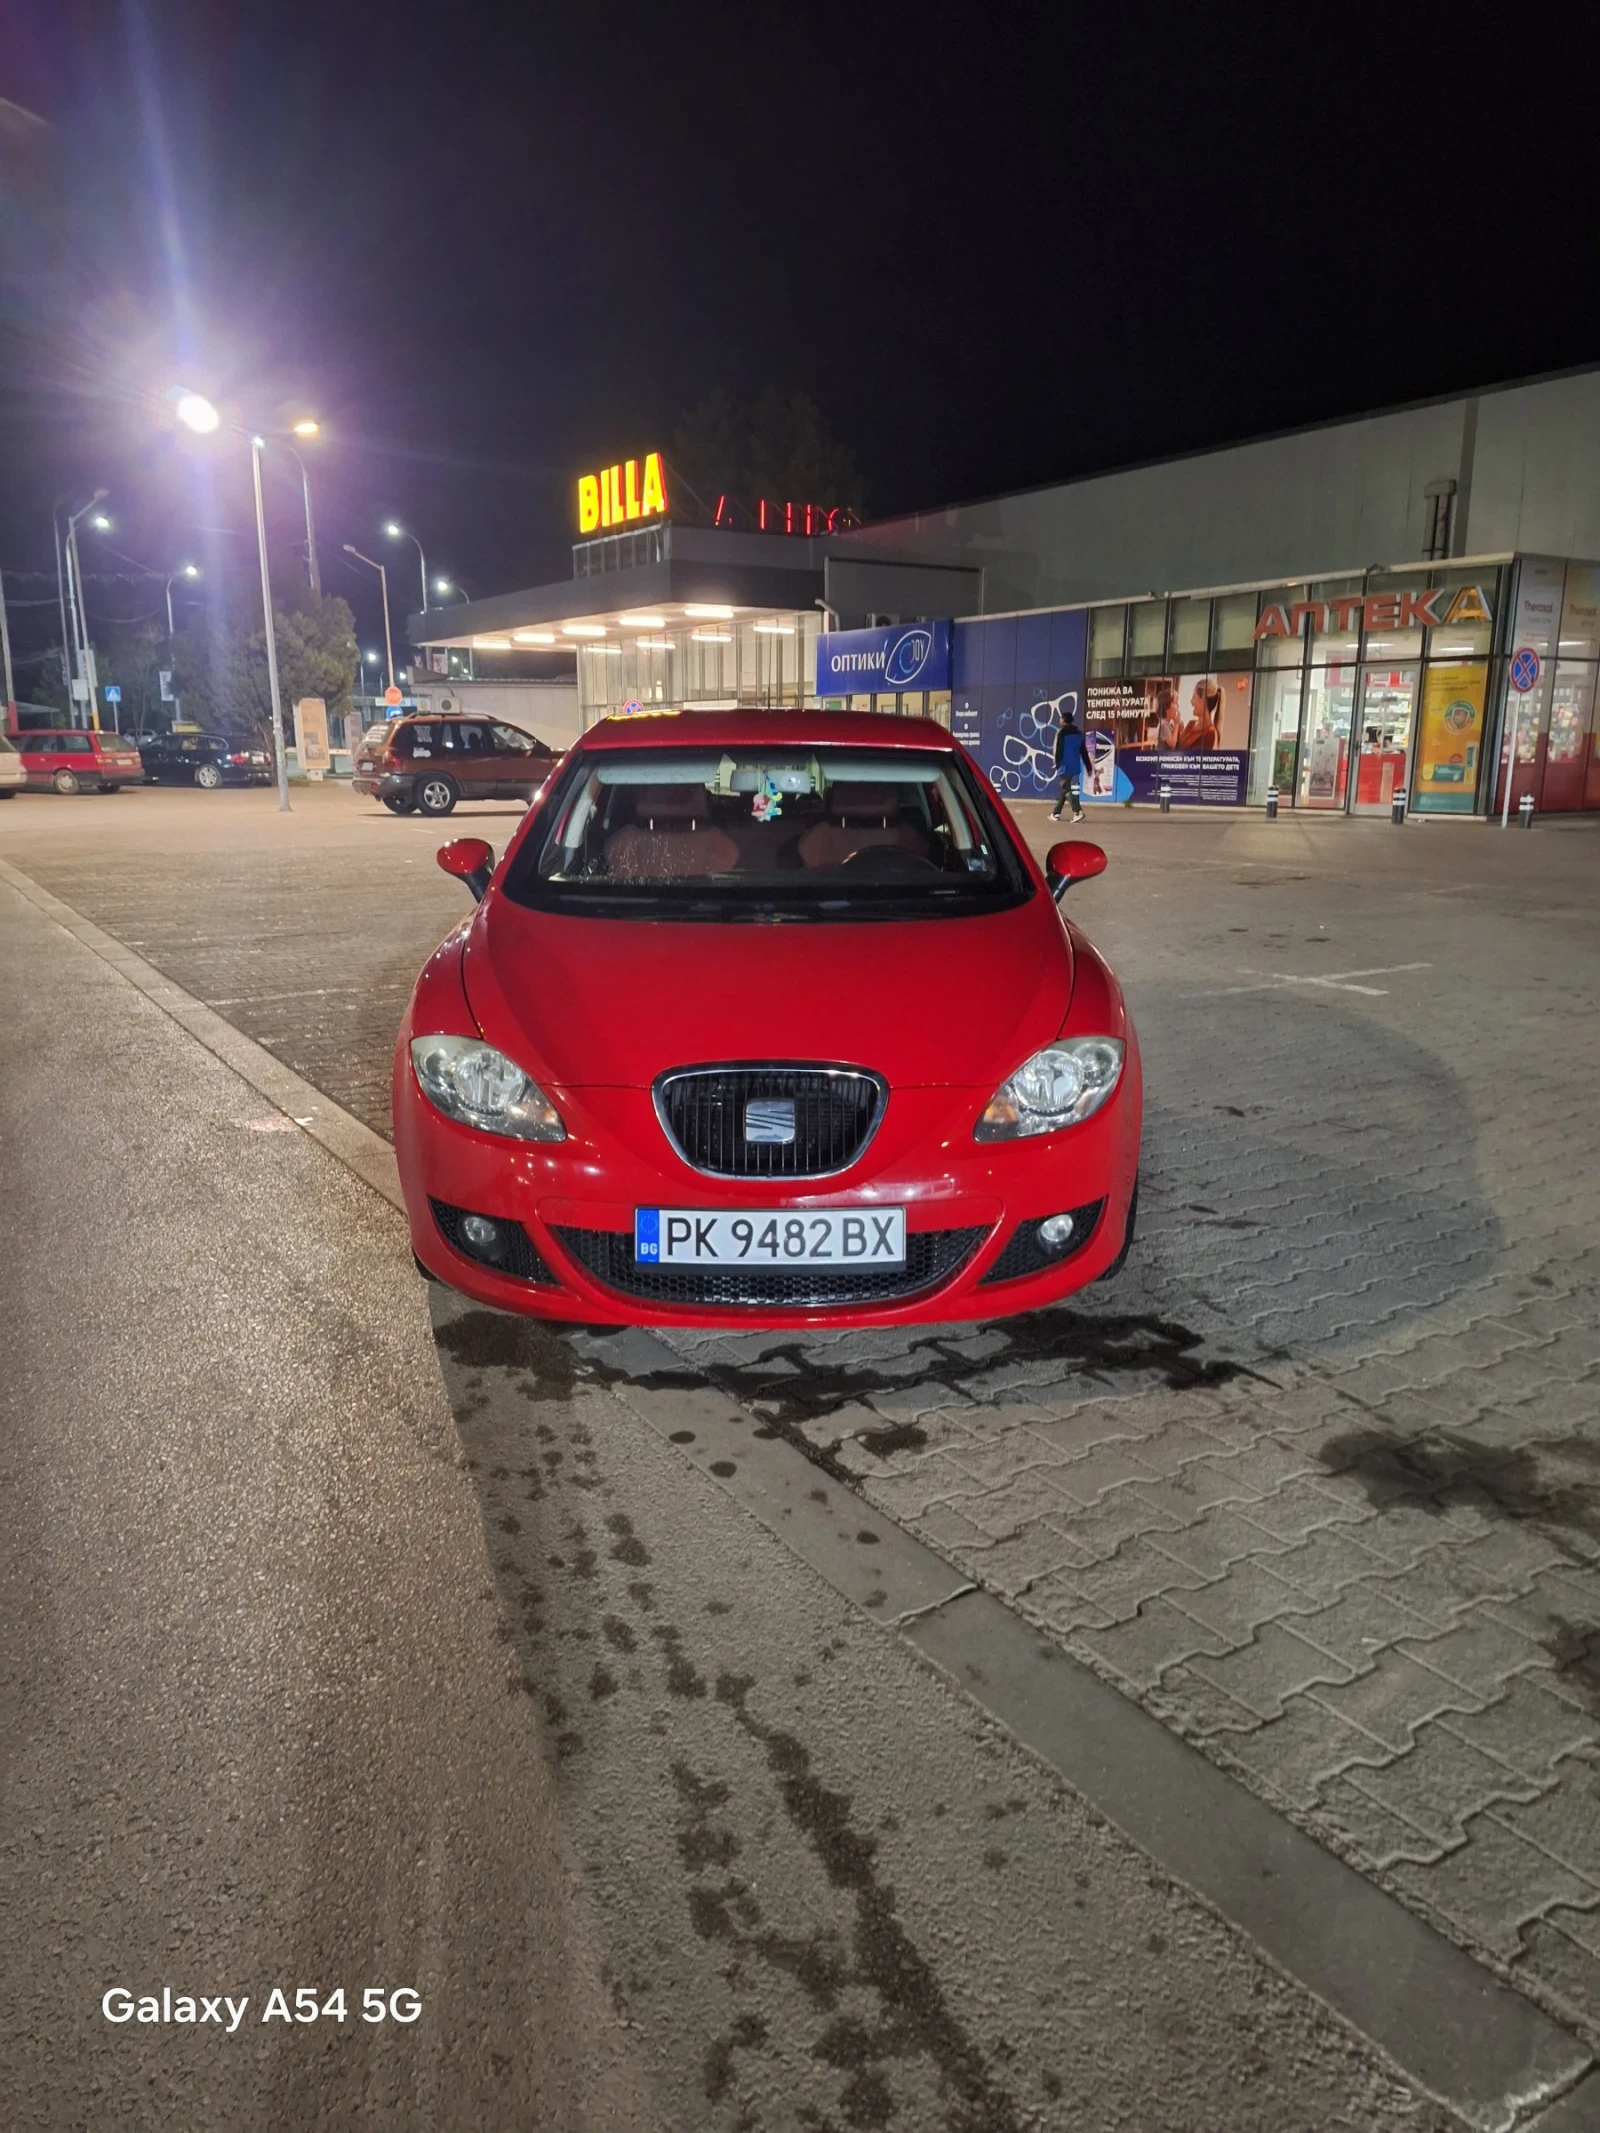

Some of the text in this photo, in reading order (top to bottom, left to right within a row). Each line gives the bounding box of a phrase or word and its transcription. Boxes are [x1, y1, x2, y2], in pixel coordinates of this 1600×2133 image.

[578, 452, 668, 533] BILLA
[1254, 585, 1493, 639] АПТЕКА
[831, 651, 886, 672] ОПТИКИ
[911, 638, 925, 663] JOY
[1086, 709, 1151, 720] СЛЕД 15 МИНУТИ
[640, 1242, 658, 1255] BG
[667, 1216, 895, 1258] PK 9482 BX
